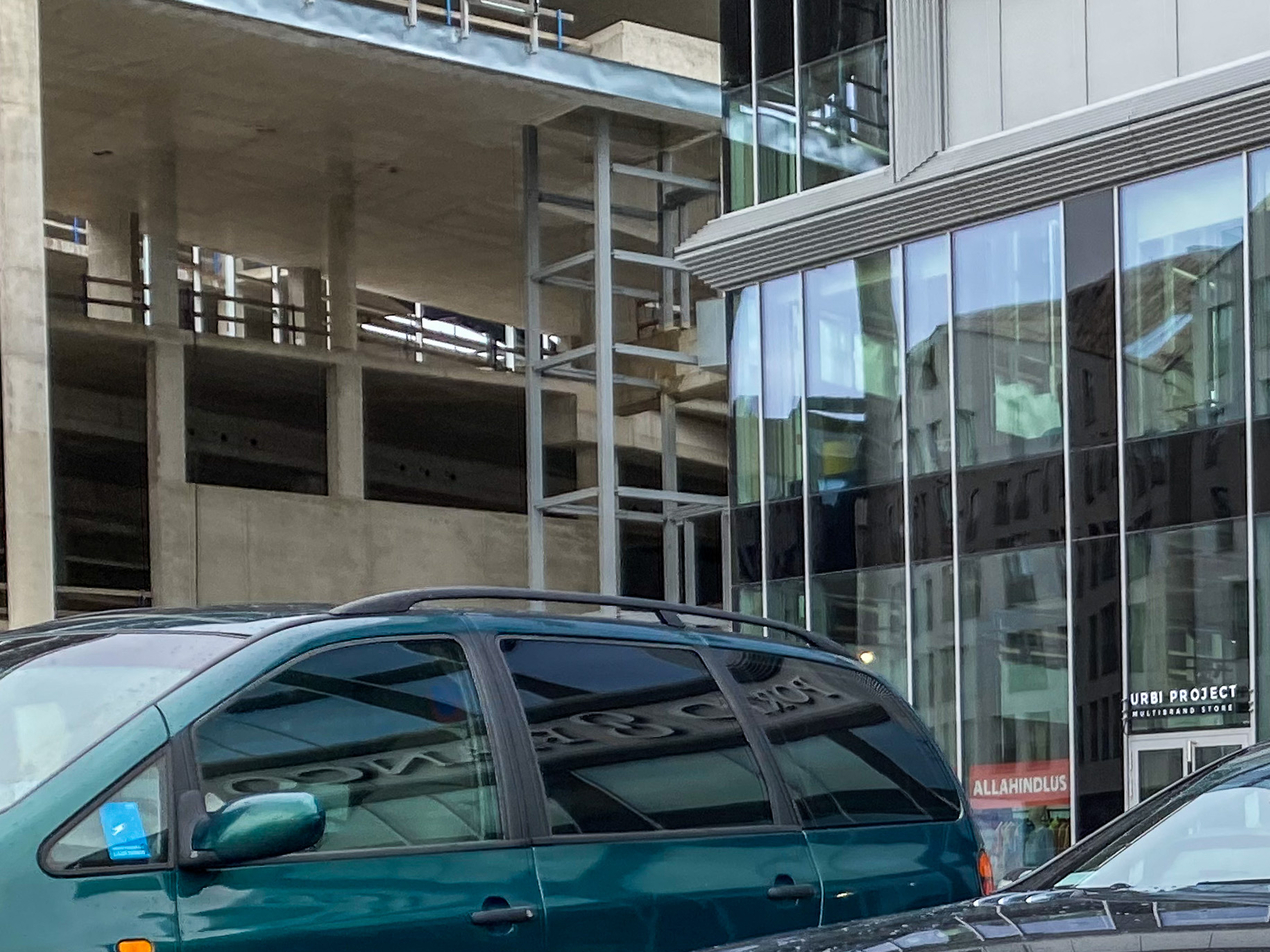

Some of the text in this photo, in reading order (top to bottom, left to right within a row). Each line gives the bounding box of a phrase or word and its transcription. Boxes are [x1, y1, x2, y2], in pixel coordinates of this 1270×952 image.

[1130, 684, 1238, 706] URBI PROJECT
[1131, 703, 1233, 717] MULTIBRAND STORE
[973, 774, 1067, 796] ALLAHINDLUS
